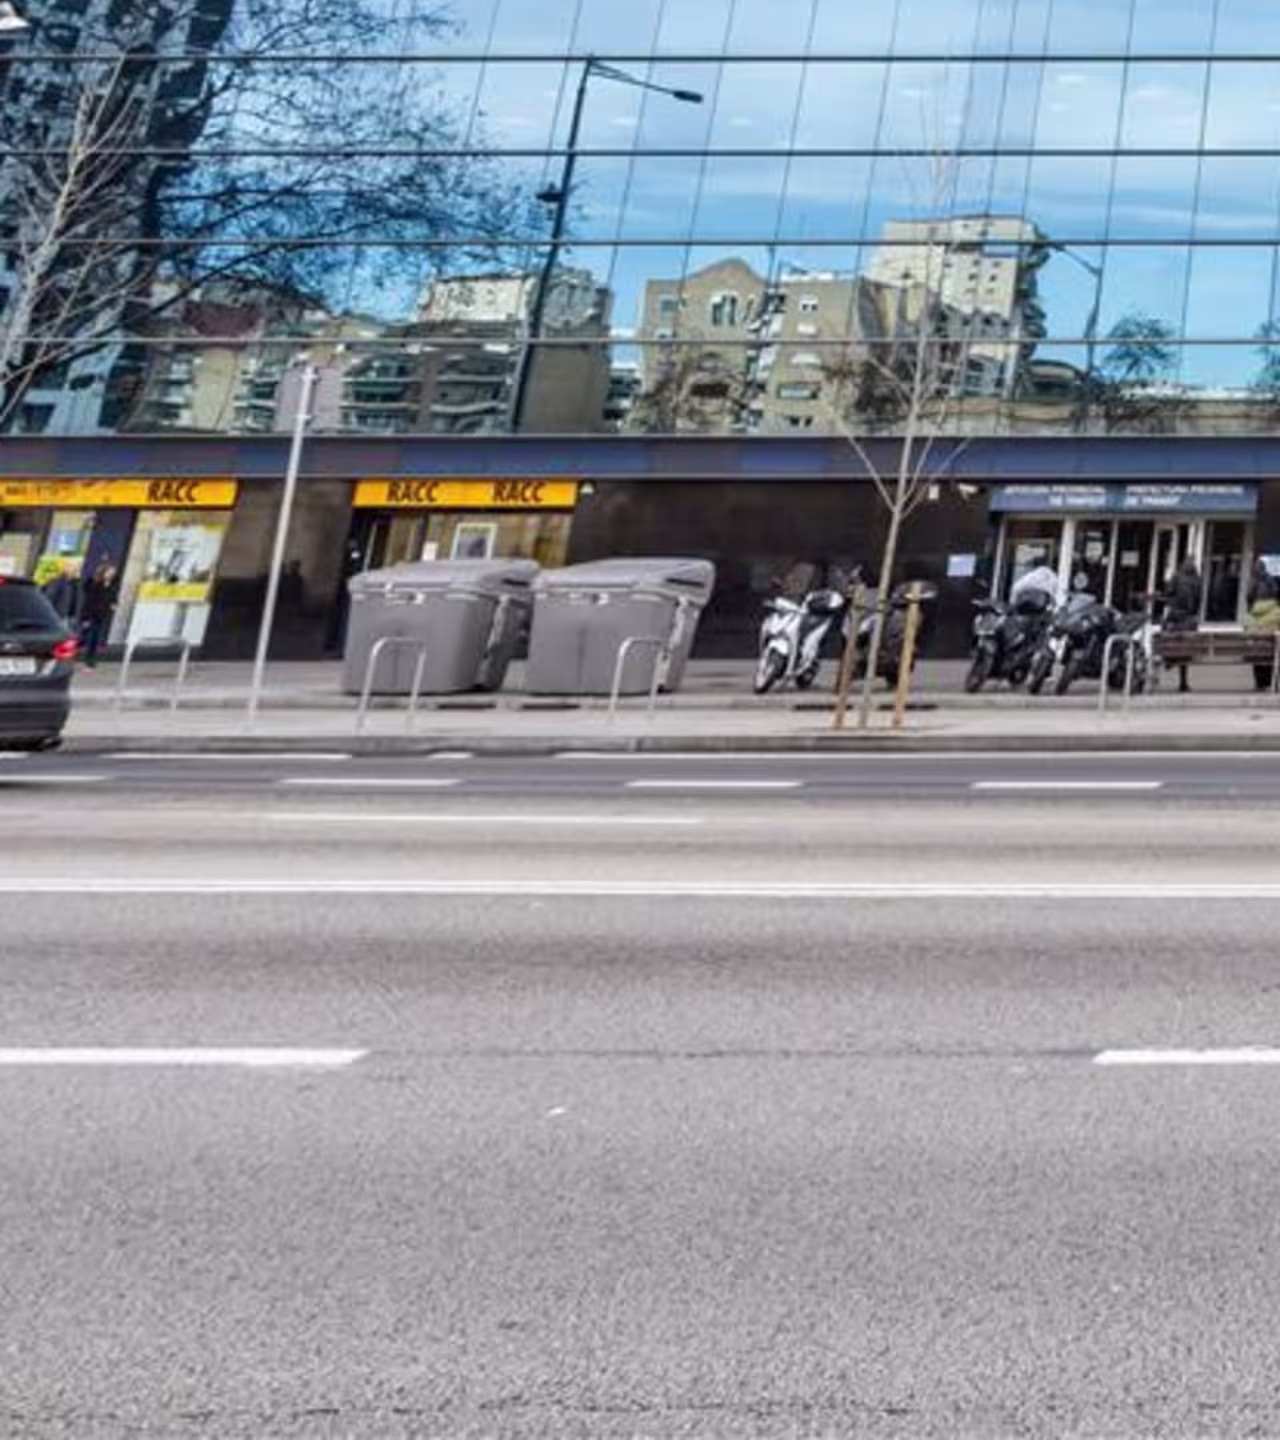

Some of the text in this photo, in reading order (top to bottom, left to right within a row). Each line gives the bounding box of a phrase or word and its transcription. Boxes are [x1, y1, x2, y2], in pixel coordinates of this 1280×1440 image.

[148, 478, 200, 502] RACC
[386, 478, 440, 502] RACC
[493, 478, 546, 502] RACC
